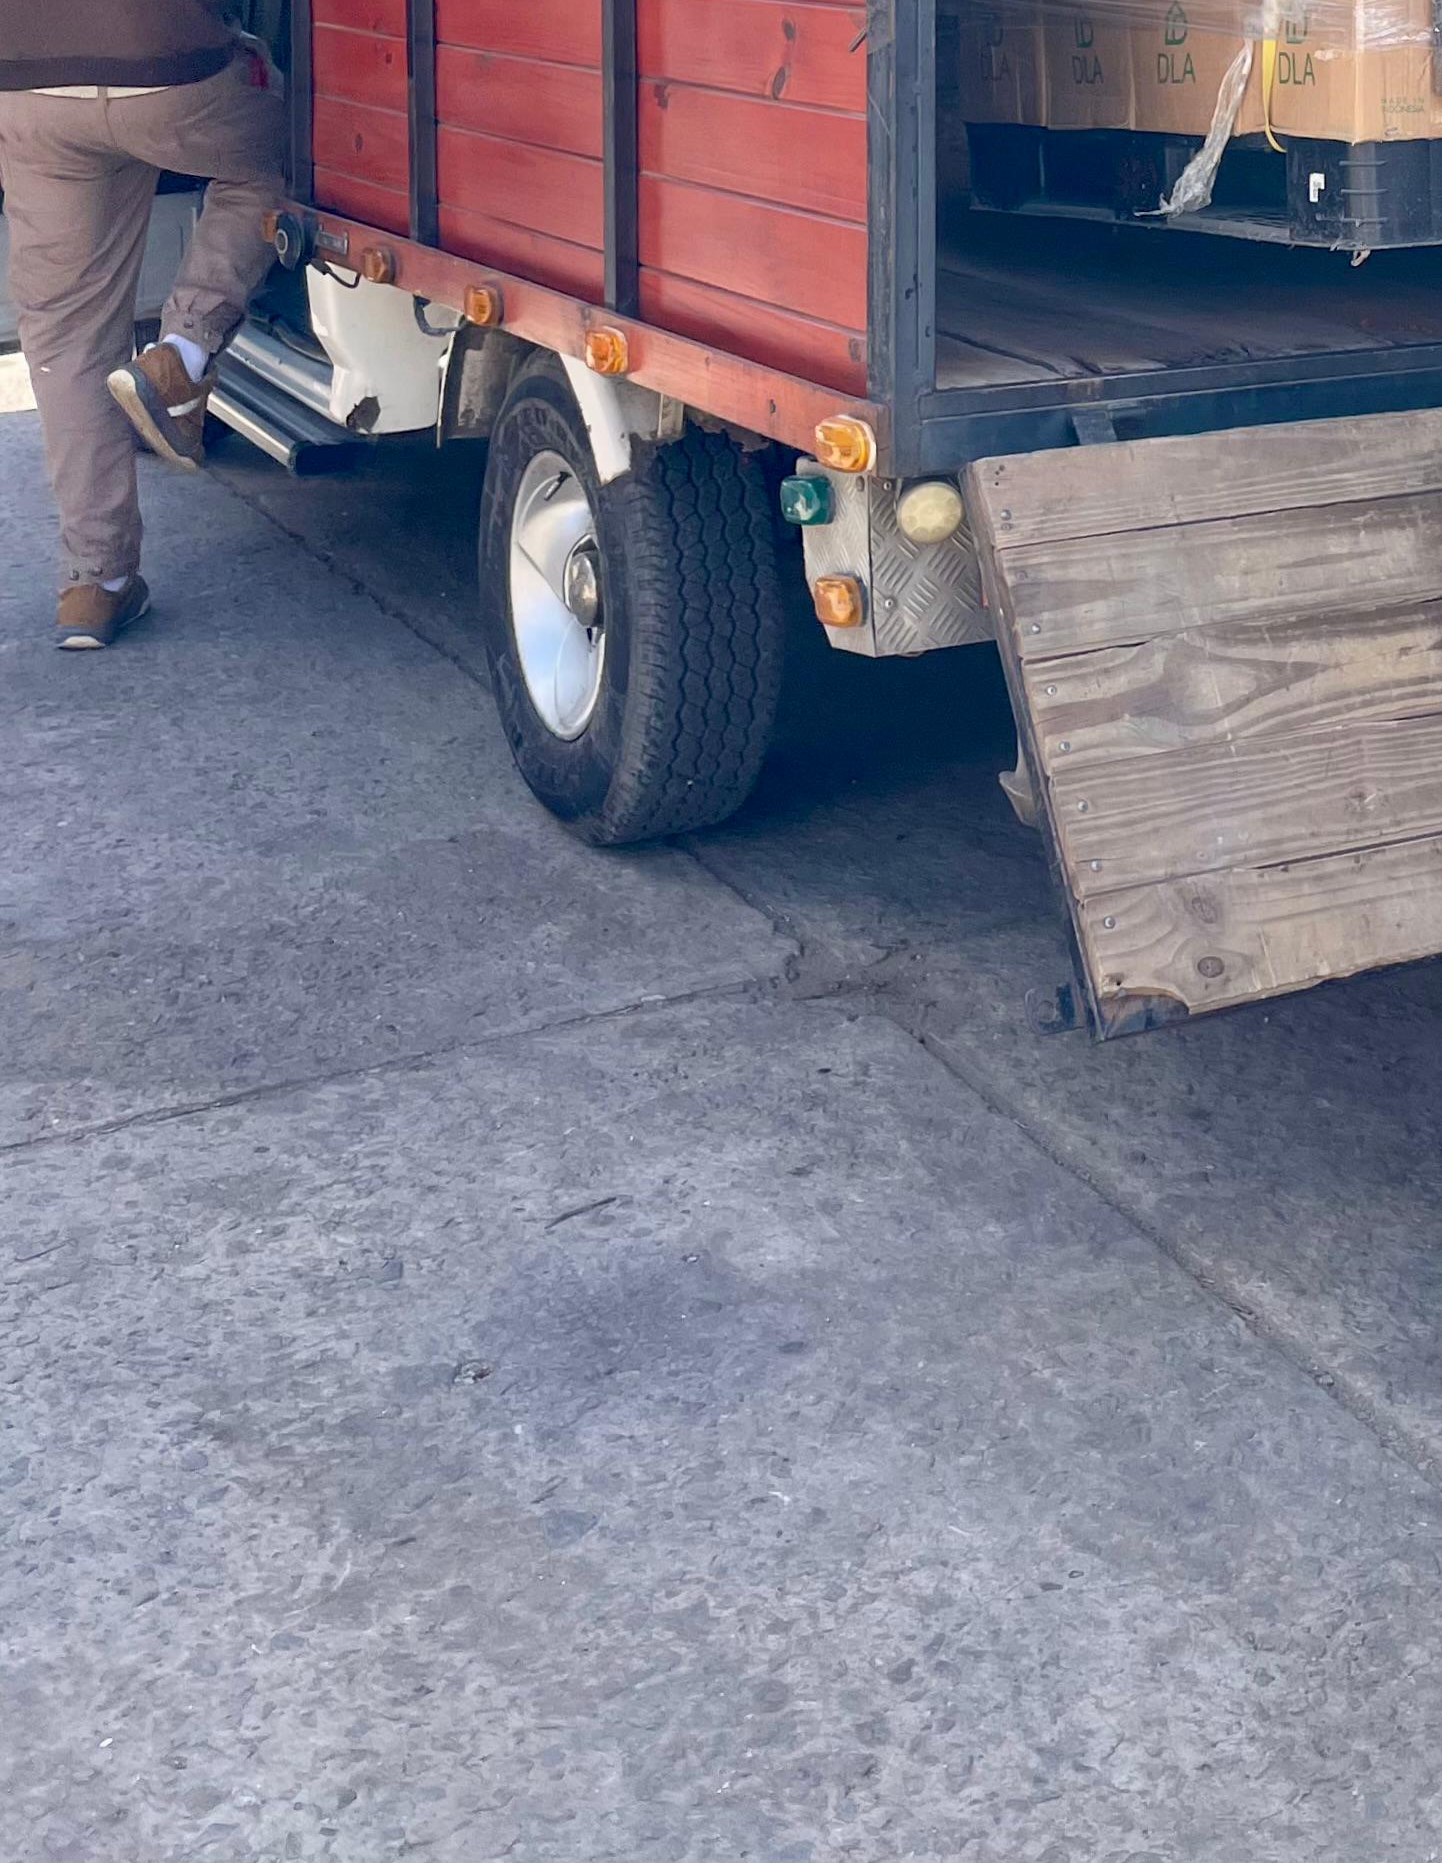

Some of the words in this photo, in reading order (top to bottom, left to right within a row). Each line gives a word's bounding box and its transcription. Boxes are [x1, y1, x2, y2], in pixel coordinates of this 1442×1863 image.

[1071, 55, 1104, 85] DLA
[1157, 52, 1197, 85] DLA
[1278, 51, 1316, 86] DLA
